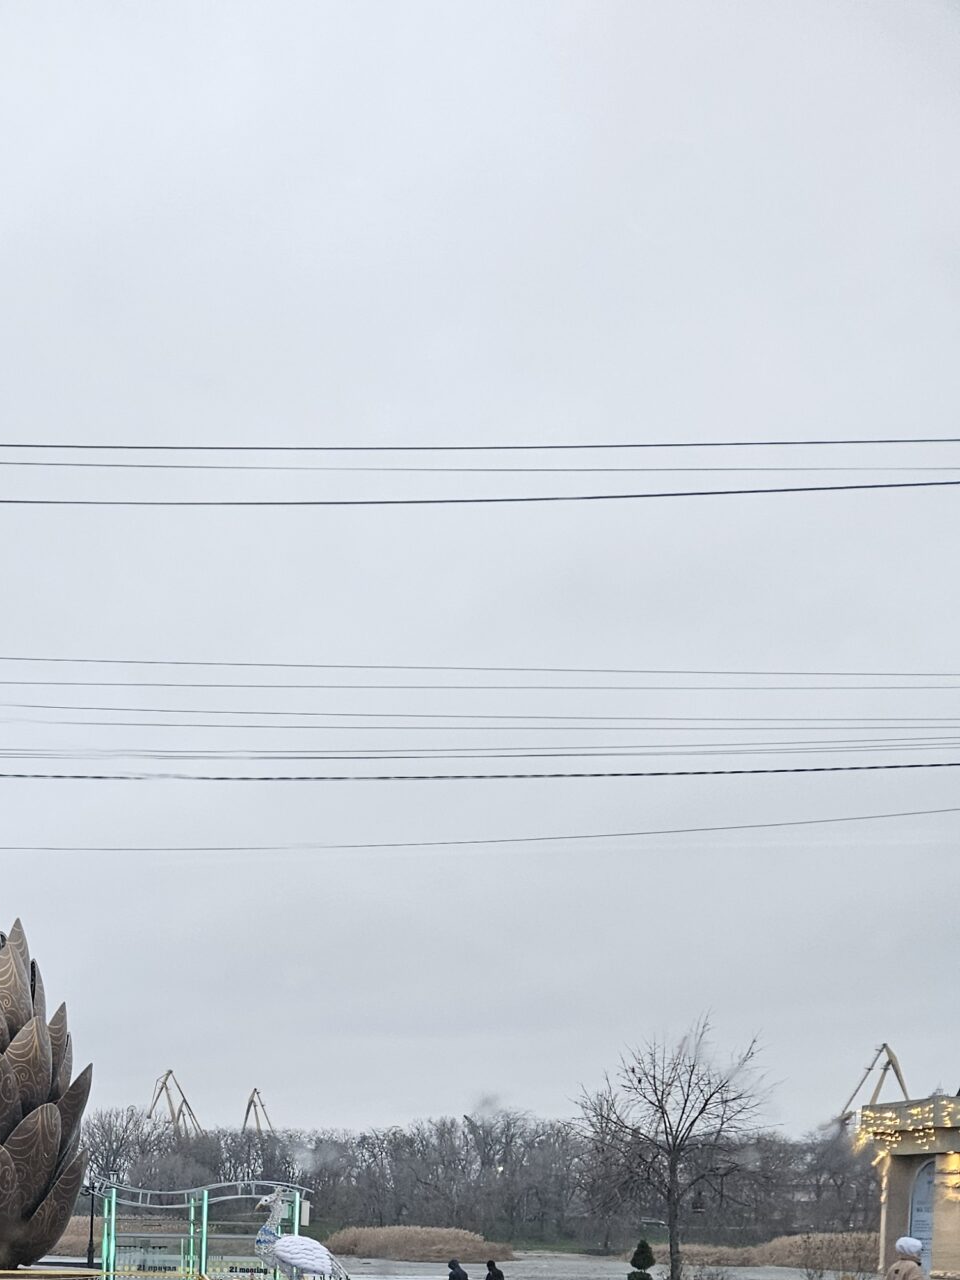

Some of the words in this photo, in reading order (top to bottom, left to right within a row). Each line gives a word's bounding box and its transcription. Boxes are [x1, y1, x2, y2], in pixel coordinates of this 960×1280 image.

[137, 1263, 145, 1272] 21
[148, 1265, 177, 1273] причал
[229, 1265, 238, 1273] 21
[239, 1266, 268, 1276] mooring
